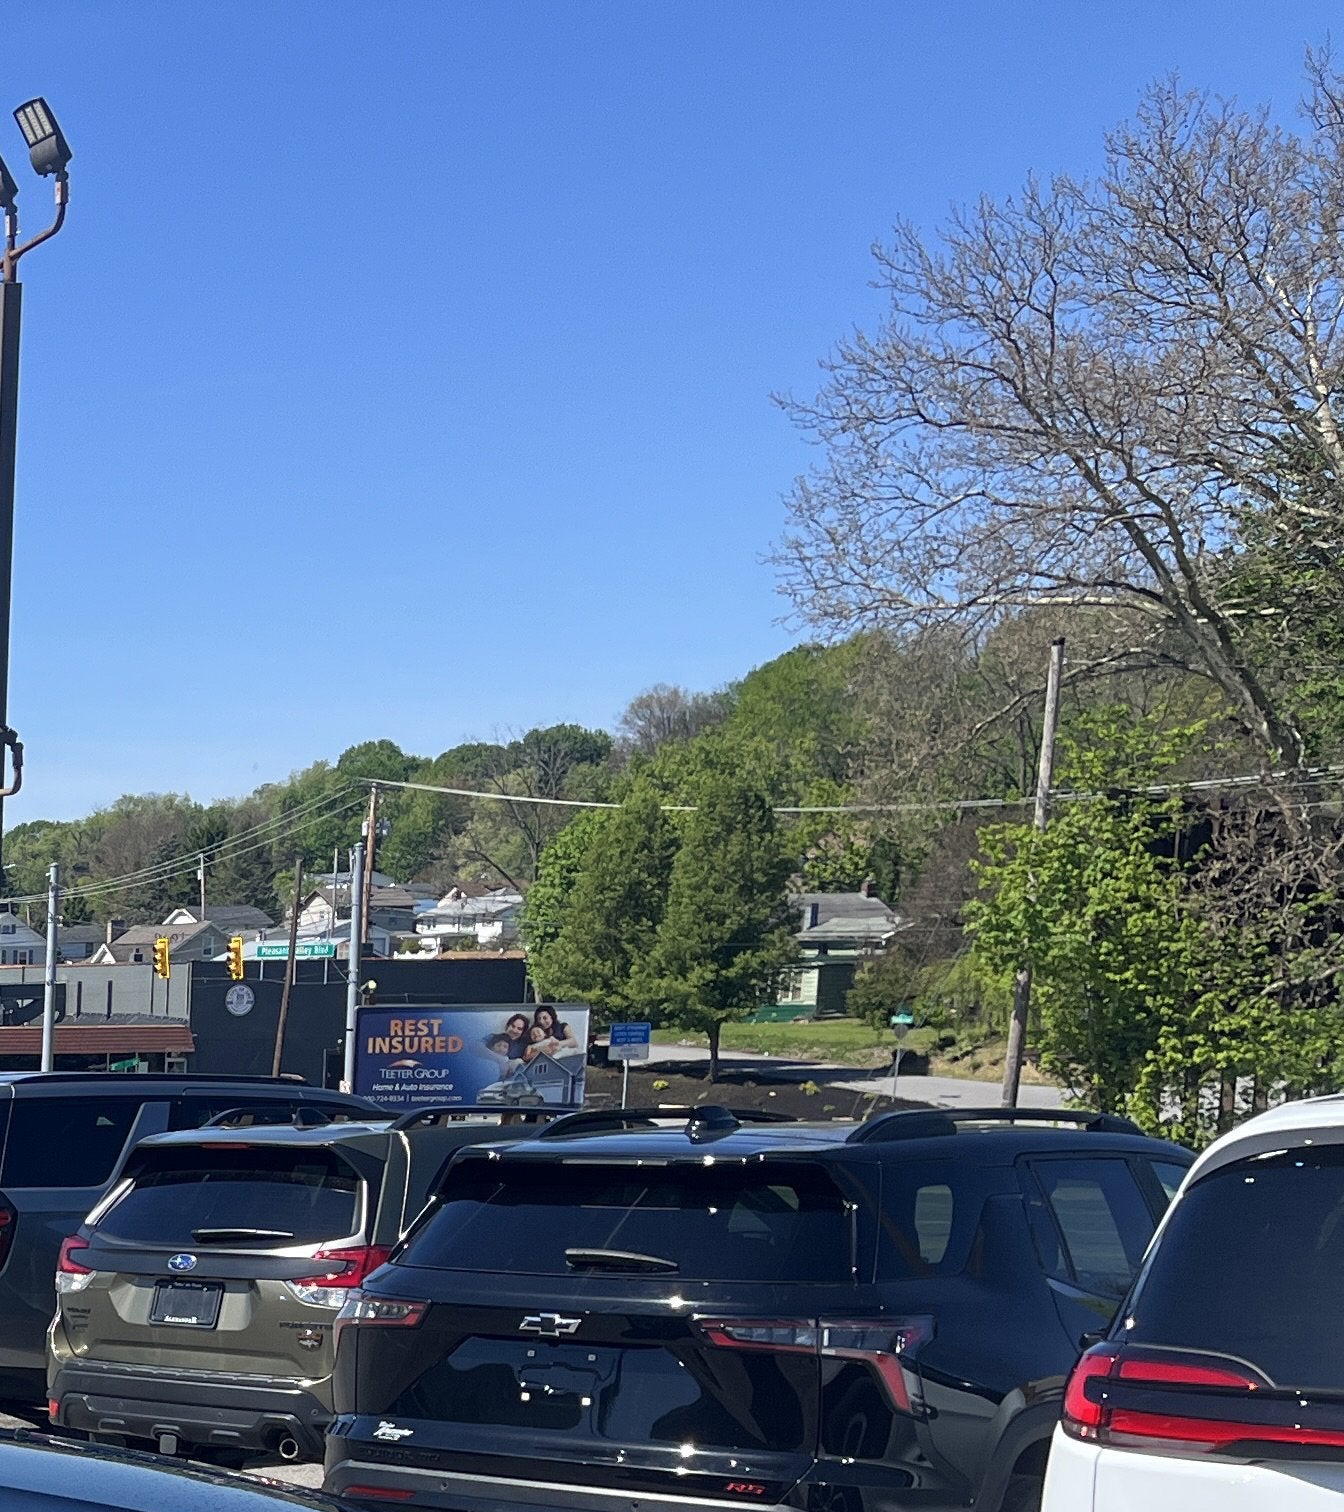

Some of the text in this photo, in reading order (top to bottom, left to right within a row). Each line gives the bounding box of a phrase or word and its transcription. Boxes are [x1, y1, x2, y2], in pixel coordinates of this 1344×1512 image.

[389, 1018, 444, 1037] REST
[367, 1036, 465, 1055] INSURED
[379, 1068, 450, 1080] TEETER GROUP
[372, 1083, 394, 1092] Home
[401, 1083, 418, 1092] Auto
[419, 1083, 454, 1092] Insurance
[726, 1482, 767, 1495] RS
